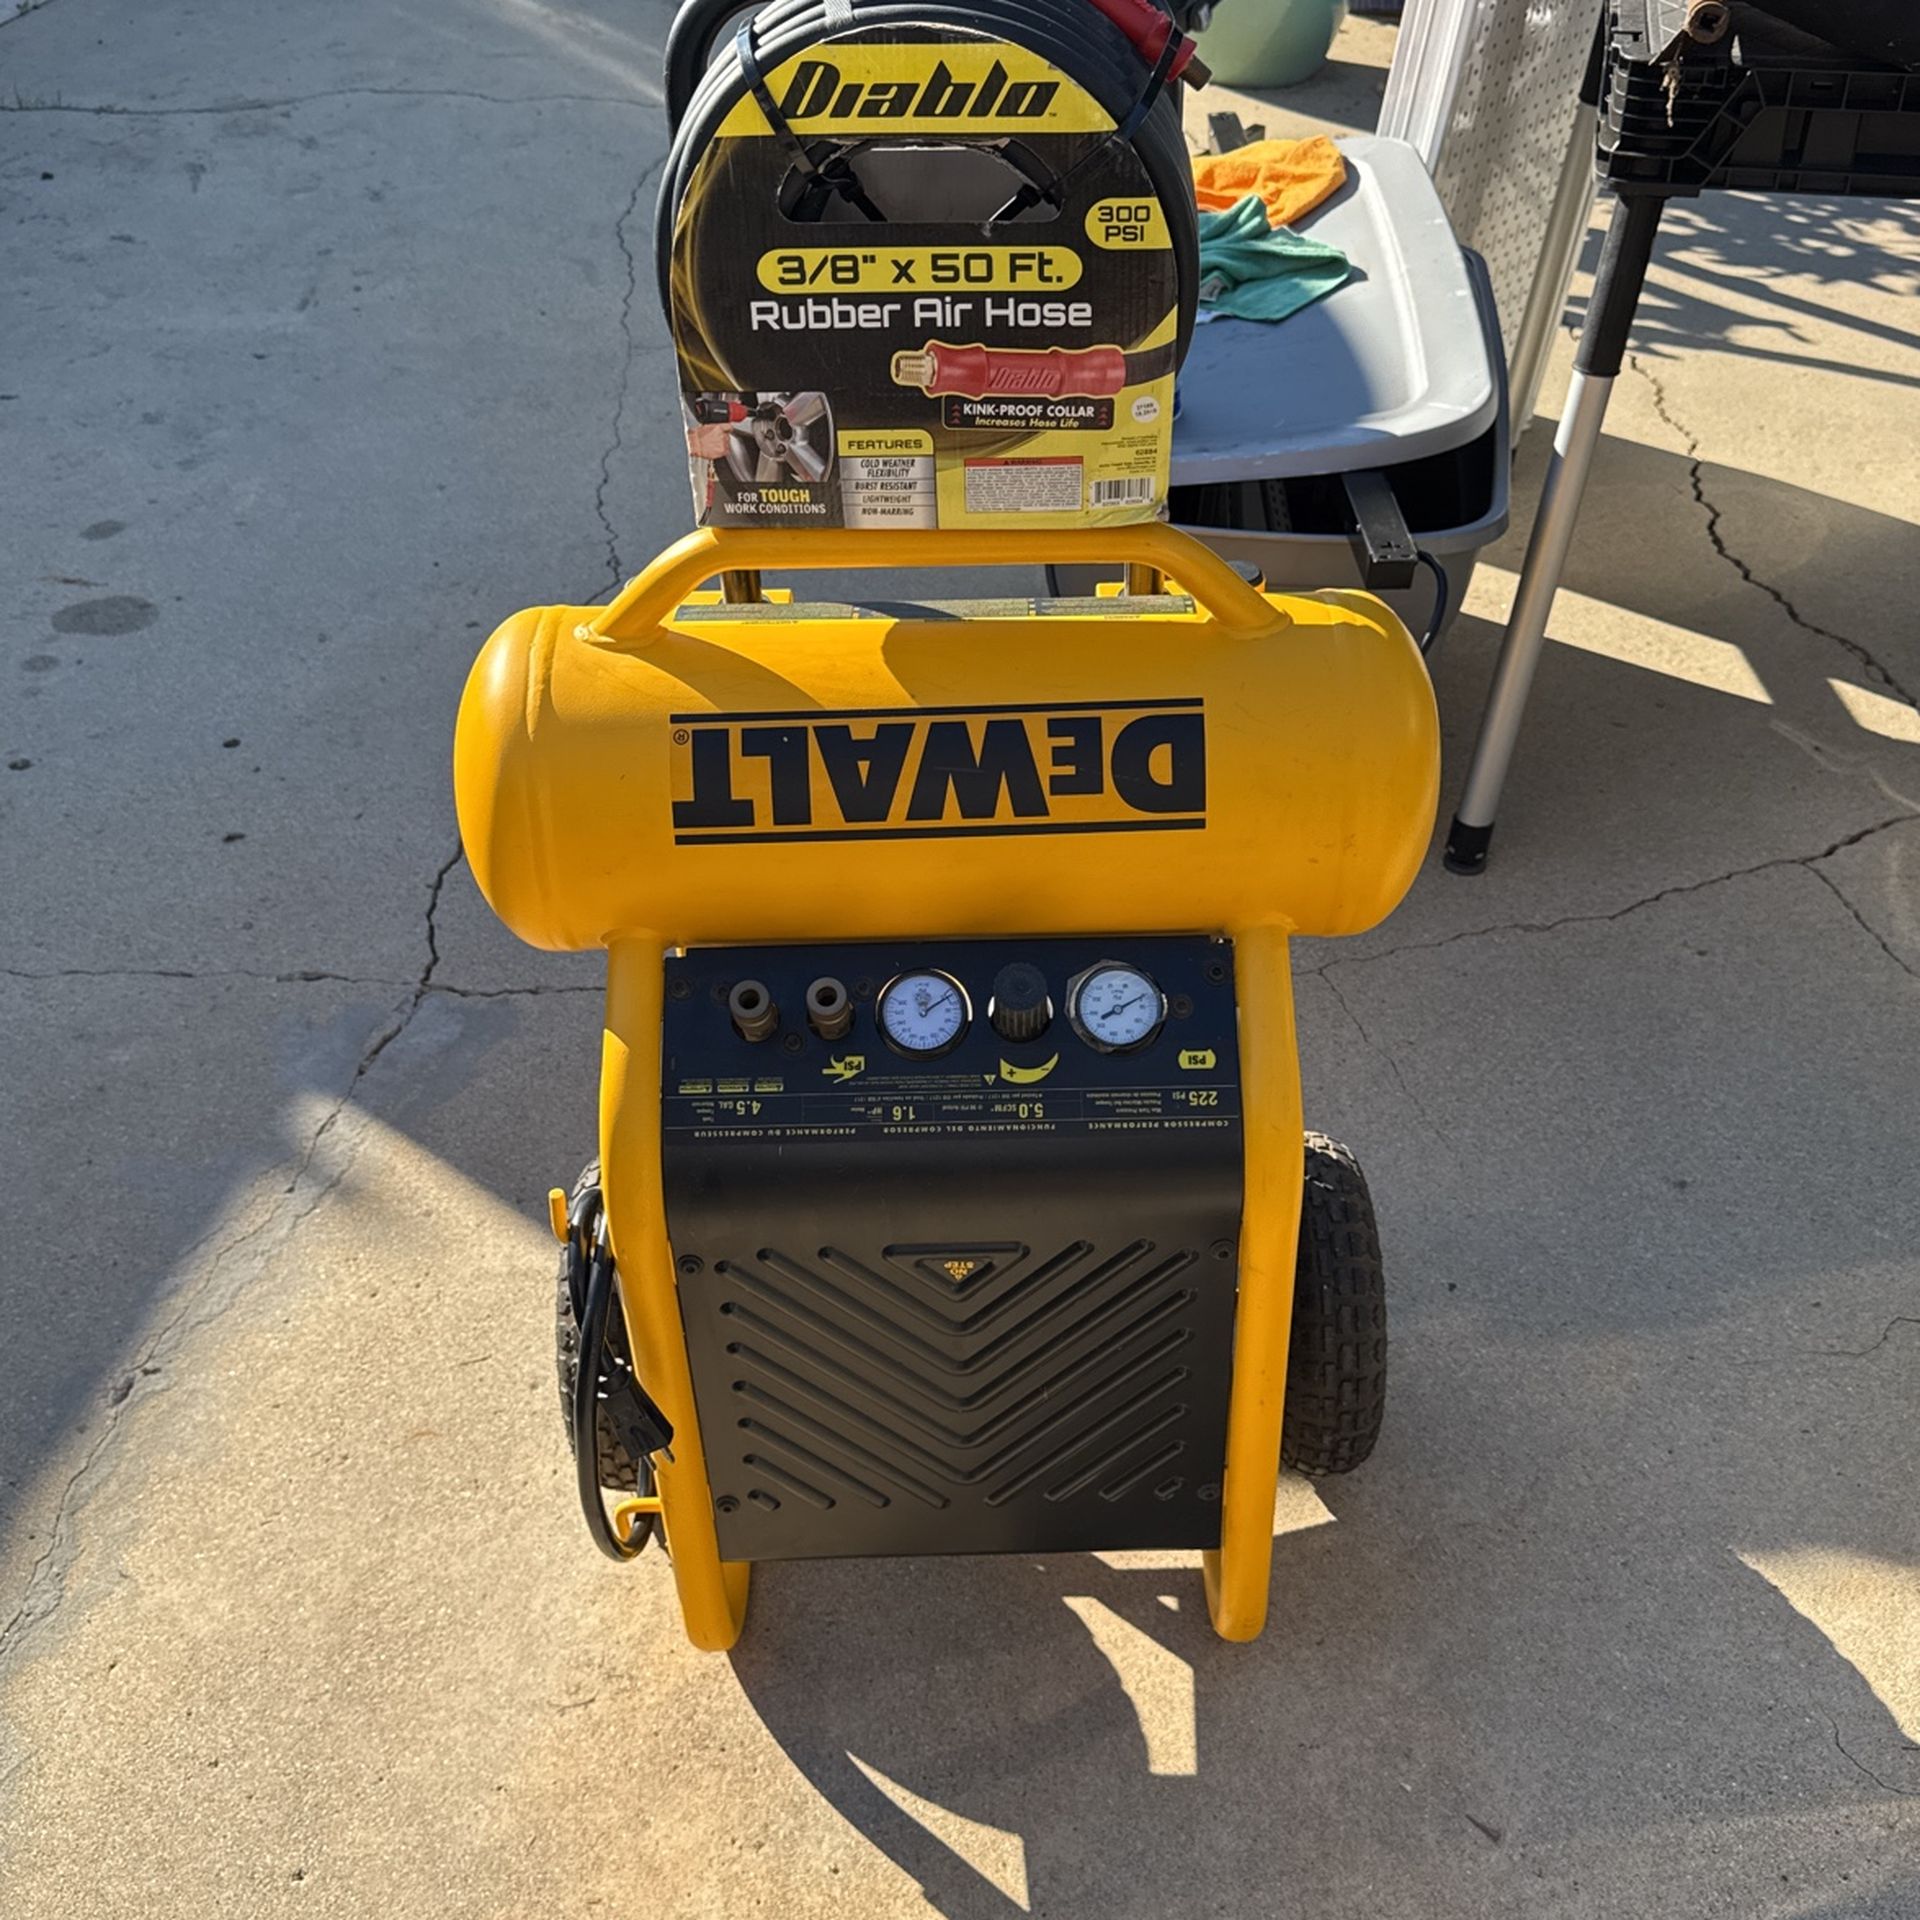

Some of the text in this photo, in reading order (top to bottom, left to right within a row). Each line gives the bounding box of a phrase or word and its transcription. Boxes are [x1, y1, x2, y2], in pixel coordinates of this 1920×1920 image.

[778, 59, 1061, 120] Diablo
[1097, 205, 1151, 223] 300
[1104, 225, 1145, 242] PSI
[776, 251, 1064, 286] 3/8" x 50 Ft.
[749, 295, 1093, 331] Rubber Air Hose
[962, 403, 1096, 418] KINK-PROOF COLLAR
[974, 416, 1080, 429] Increases Hose Life
[847, 439, 924, 451] FEATURES
[860, 458, 917, 469] COLD WEATHER
[867, 468, 911, 478] FLEXIBILITY
[855, 481, 918, 491] BURST RESISTANT
[737, 488, 811, 503] FOR TOUGH
[862, 494, 912, 504] LIGHTWEIGHT
[723, 502, 827, 515] WORK CONDITIONS
[861, 507, 915, 516] NON-MARRING
[843, 1060, 862, 1071] PSI
[1187, 1054, 1207, 1066] PSI
[1188, 1090, 1218, 1106] 225
[736, 1100, 761, 1115] 4.5
[892, 1105, 916, 1121] 1.6
[1018, 1103, 1044, 1118] 5.0
[883, 1122, 1056, 1134] FUNCIONAMIENTO DEL COMPRESOR
[1088, 1120, 1229, 1130] COMPRESSOR PERFORMANCE
[693, 1129, 764, 1138] COMPRESSEUR
[785, 1128, 856, 1136] PERFORMANCE
